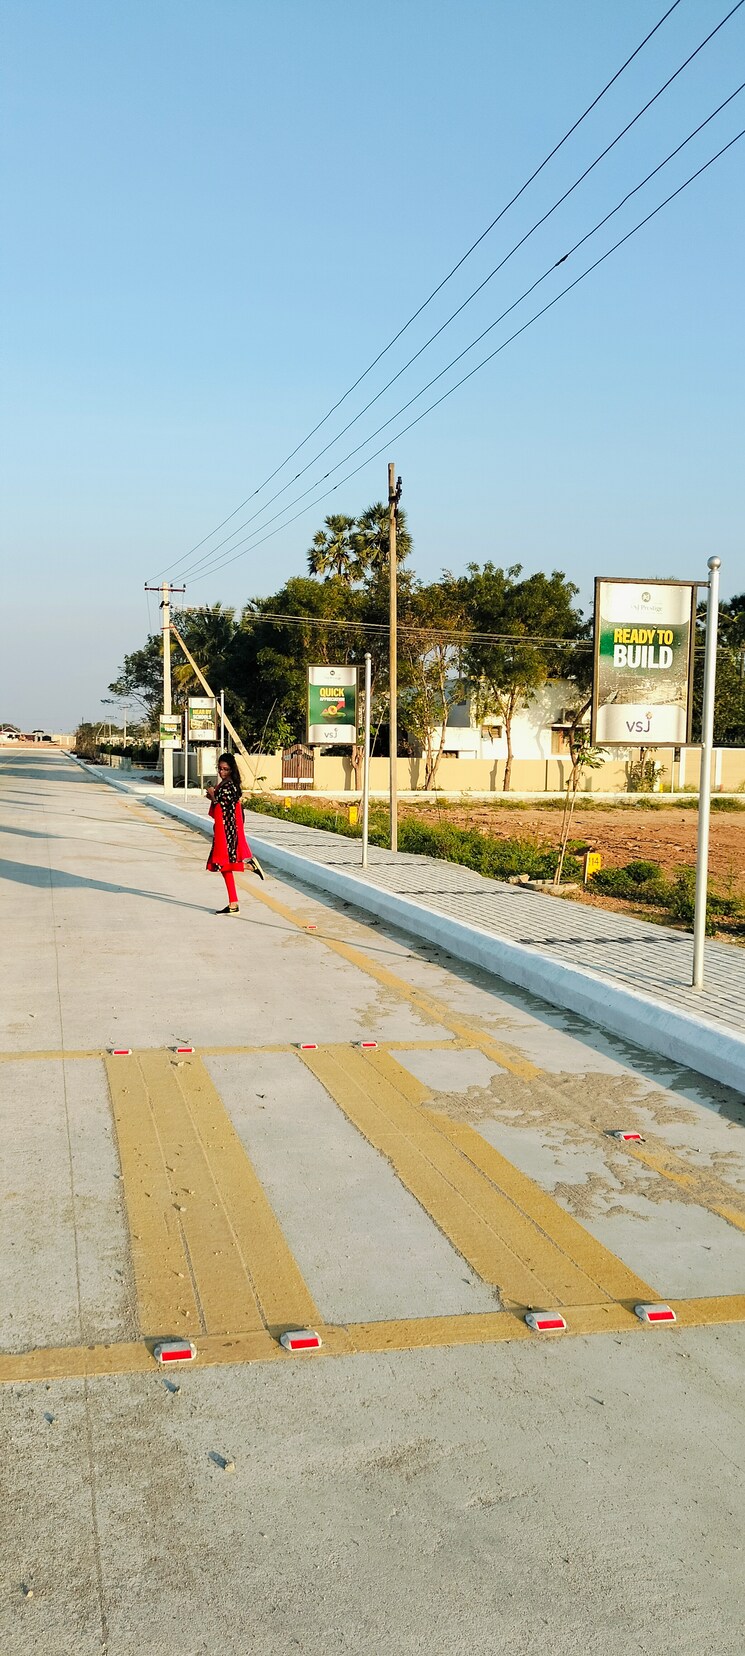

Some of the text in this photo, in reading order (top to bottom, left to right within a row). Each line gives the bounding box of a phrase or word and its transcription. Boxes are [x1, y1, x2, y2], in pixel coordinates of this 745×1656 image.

[614, 628, 673, 645] READY TO
[613, 644, 673, 669] BUILD
[320, 688, 344, 697] QUICK
